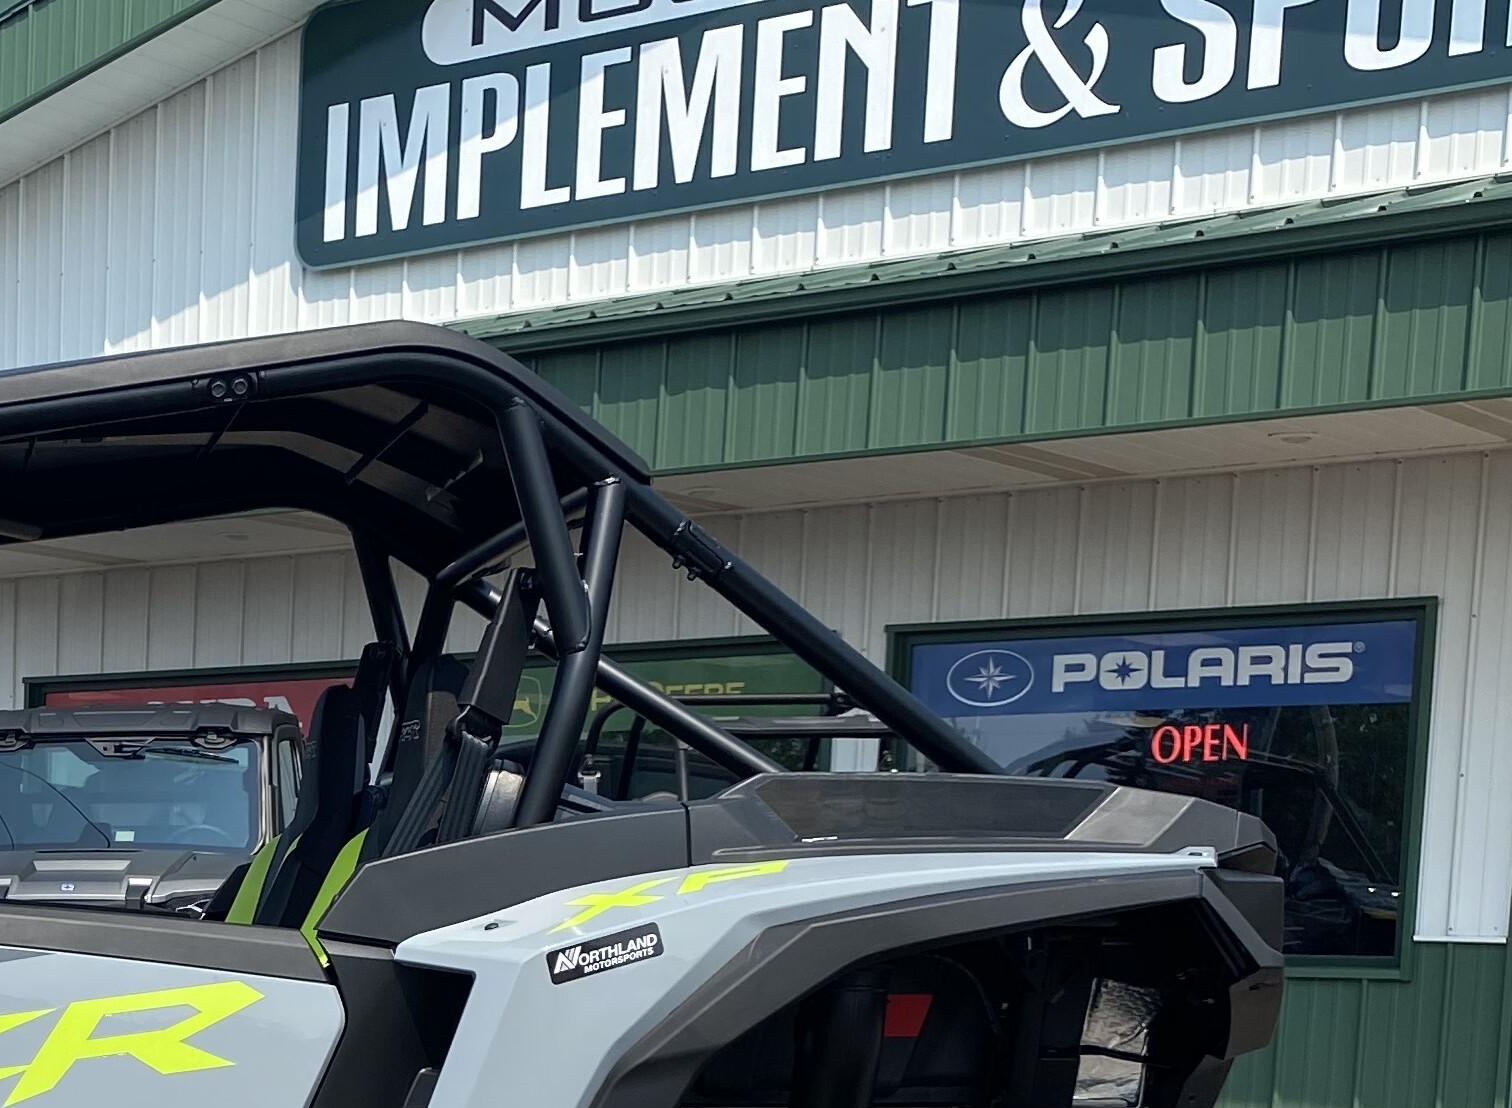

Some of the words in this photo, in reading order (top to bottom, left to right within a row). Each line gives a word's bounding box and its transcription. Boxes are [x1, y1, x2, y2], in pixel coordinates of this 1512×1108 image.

[322, 0, 960, 243] IMPLEMENT
[998, 0, 1122, 128] &
[1051, 641, 1355, 694] POLARIS
[1151, 723, 1249, 765] OPEN
[583, 946, 655, 974] MOTORSPORTS
